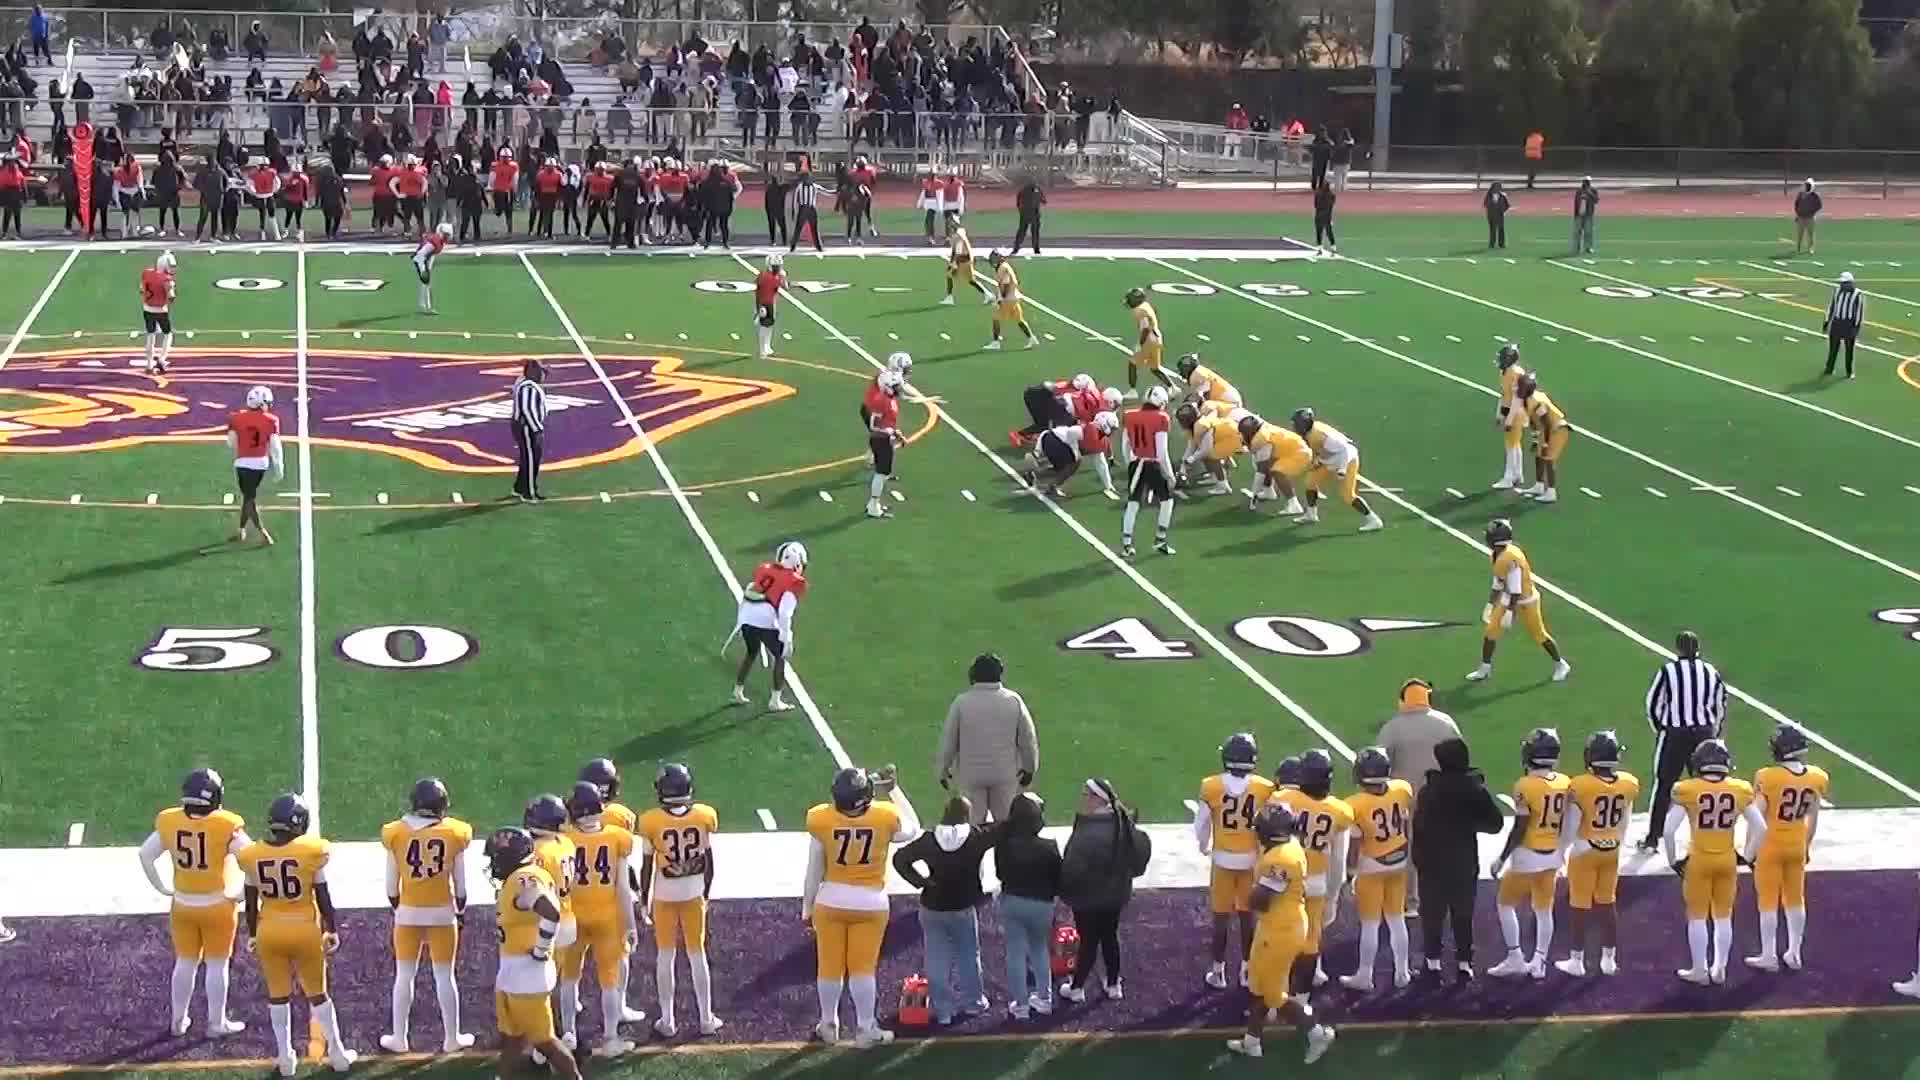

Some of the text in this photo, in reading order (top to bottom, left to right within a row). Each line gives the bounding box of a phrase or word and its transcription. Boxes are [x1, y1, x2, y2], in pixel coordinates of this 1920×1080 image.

[1133, 421, 1149, 449] 11
[1221, 792, 1257, 830] 24
[1370, 801, 1406, 843] 34
[1536, 792, 1565, 834] 19
[1590, 793, 1626, 830] 36
[1697, 792, 1736, 830] 22
[1776, 786, 1816, 823] 26
[175, 829, 209, 871] 51
[662, 826, 701, 865] 32
[833, 827, 874, 867] 77
[1293, 810, 1333, 851] 42
[405, 838, 446, 879] 43
[574, 844, 612, 886] 44
[256, 858, 302, 900] 56
